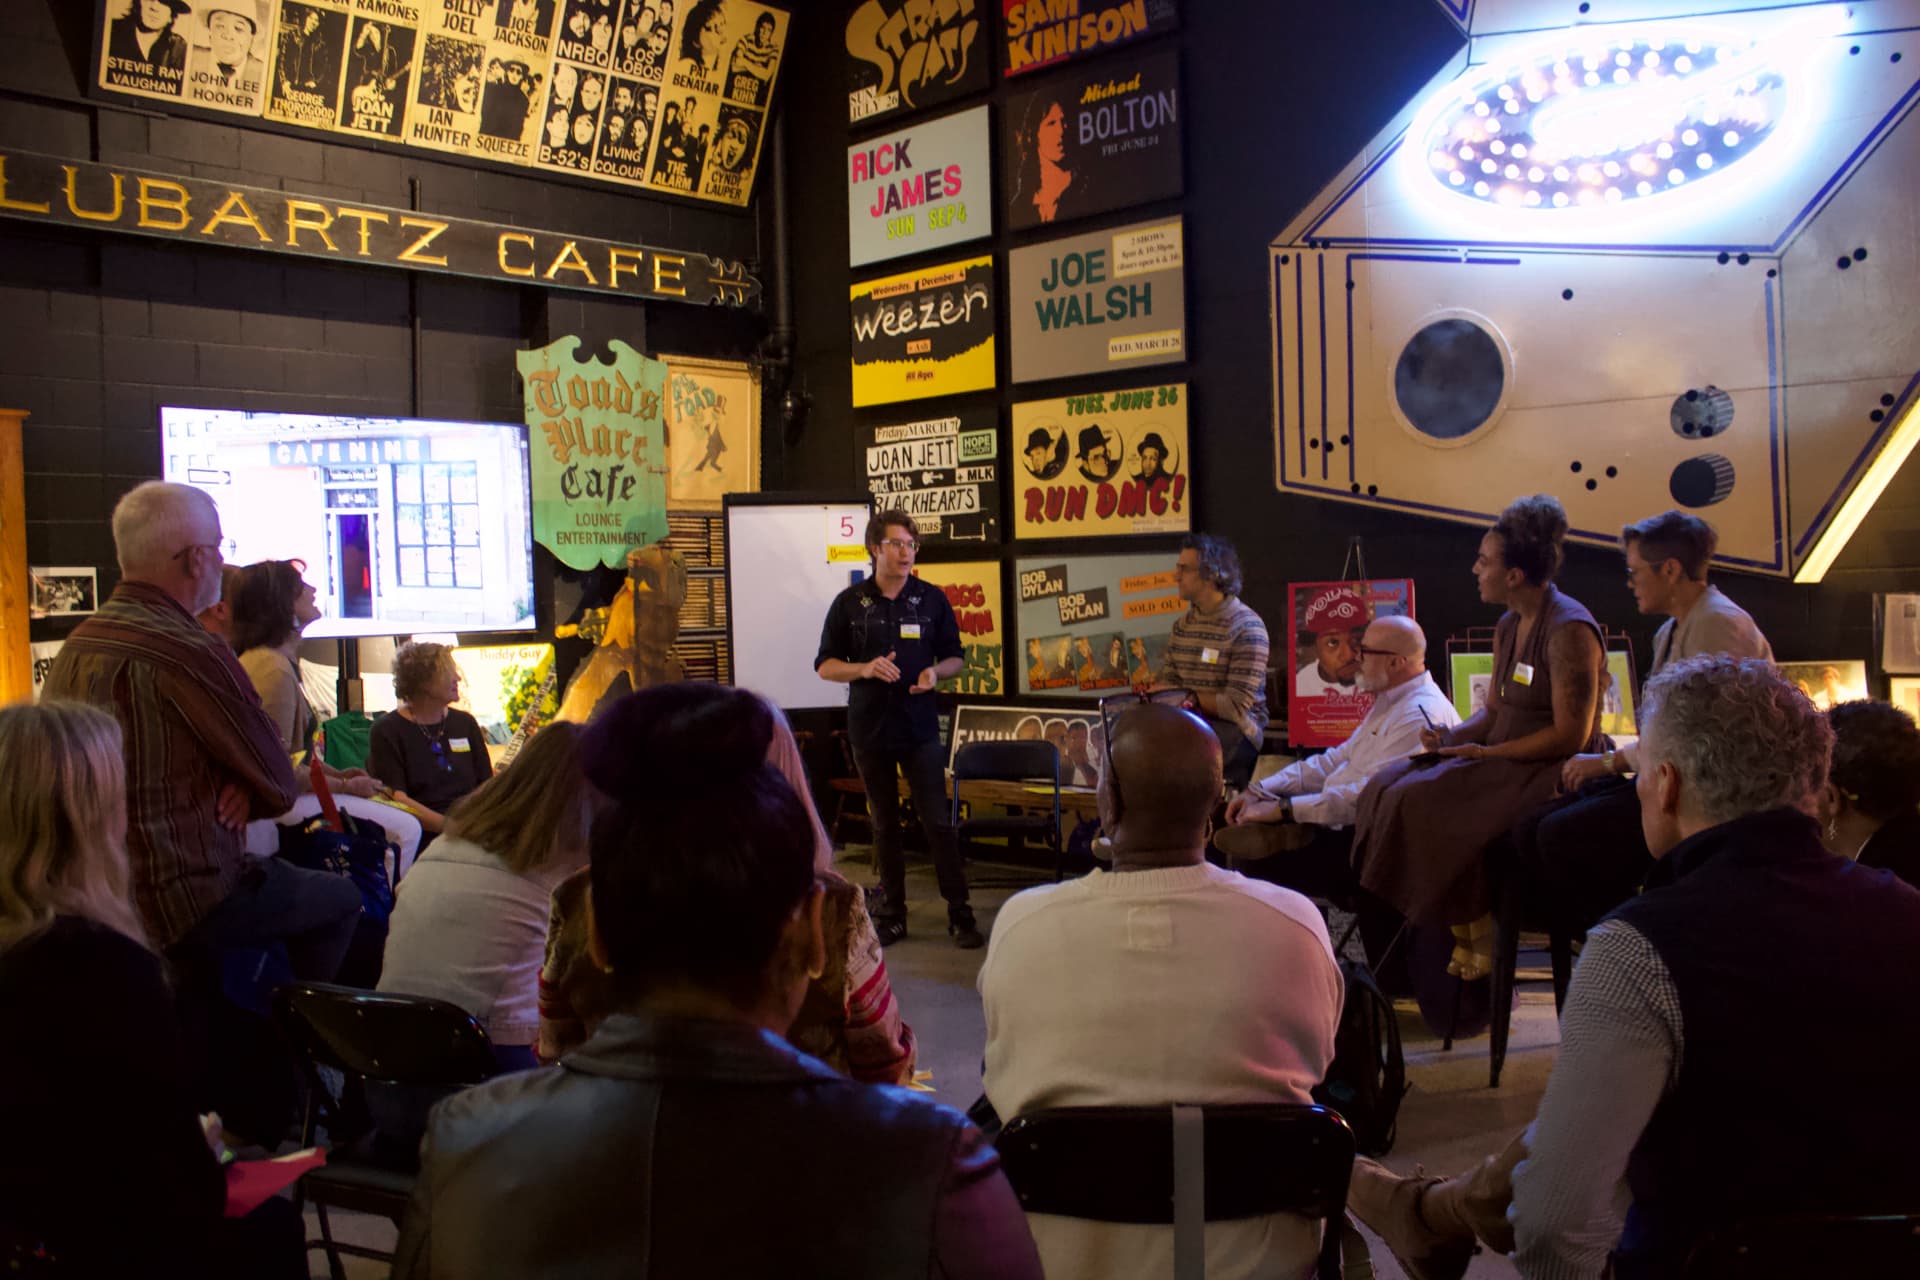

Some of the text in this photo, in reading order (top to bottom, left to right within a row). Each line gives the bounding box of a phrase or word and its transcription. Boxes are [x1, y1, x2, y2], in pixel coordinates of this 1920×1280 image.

[357, 0, 419, 21] RAMONES
[444, 0, 484, 18] BILLY
[1008, 0, 1079, 37] SAM
[442, 12, 477, 36] JOEL
[511, 16, 534, 34] JOE
[494, 27, 549, 53] JACKSON
[1008, 1, 1148, 71] KINISON
[558, 40, 609, 67] NRBQ
[626, 47, 655, 65] LOS
[900, 18, 979, 108] CATS
[108, 57, 183, 81] STEVIE RAY
[614, 57, 664, 80] LOBOS
[690, 64, 709, 79] PAT
[112, 73, 176, 94] VAUGHAN
[190, 72, 260, 93] JOHN LEE
[672, 75, 719, 95] BENATAR
[734, 75, 759, 91] GREG
[1080, 72, 1141, 104] Michael
[193, 88, 253, 108] HOOKER
[273, 97, 335, 120] THOROGOOD
[286, 90, 325, 106] GEORGE
[353, 97, 394, 118] JOAN
[351, 113, 391, 133] JETT
[429, 108, 453, 127] IAN
[1079, 88, 1177, 145] BOLTON
[413, 124, 471, 148] HUNTER
[476, 135, 530, 158] SQUEEZE
[539, 145, 589, 171] B-52's
[603, 144, 641, 162] LIVING
[852, 138, 912, 184] RICK
[595, 159, 644, 180] COLOUR
[666, 159, 687, 176] THE
[652, 172, 692, 191] ALARM
[711, 170, 741, 187] CYNDI
[704, 182, 742, 200] LAUPER
[870, 164, 962, 218] JAMES
[0, 156, 686, 297] LUBARTZ CAFE
[887, 202, 966, 240] SUN SEP 4
[921, 272, 955, 287] December
[1041, 249, 1106, 292] JOE
[854, 288, 988, 342] weezer
[1035, 282, 1152, 331] WALSH
[1135, 337, 1169, 351] MARCH
[528, 366, 662, 421] Toad's
[1110, 390, 1155, 411] JUNE
[1158, 387, 1178, 407] 26
[908, 421, 947, 437] MARCH
[541, 416, 648, 465] Place
[965, 435, 991, 449] HOPE
[276, 440, 420, 465] CAFE NINE
[869, 440, 954, 472] JOAN JETT
[561, 462, 637, 507] Cafe
[868, 472, 912, 493] and the
[968, 467, 993, 481] MLK
[875, 488, 975, 515] BLACKHEARTS
[1024, 474, 1186, 524] RUN DMC!
[576, 513, 622, 527] LOUNGE
[841, 516, 854, 537] 5
[556, 531, 647, 545] ENTERTAINMENT
[1021, 570, 1046, 585] BOB
[1022, 578, 1062, 598] DYLAN
[1058, 593, 1086, 609] BOB
[1129, 599, 1182, 613] SOLD OUT
[1060, 602, 1104, 622] DYLAN
[480, 648, 541, 661] Buddy Guy
